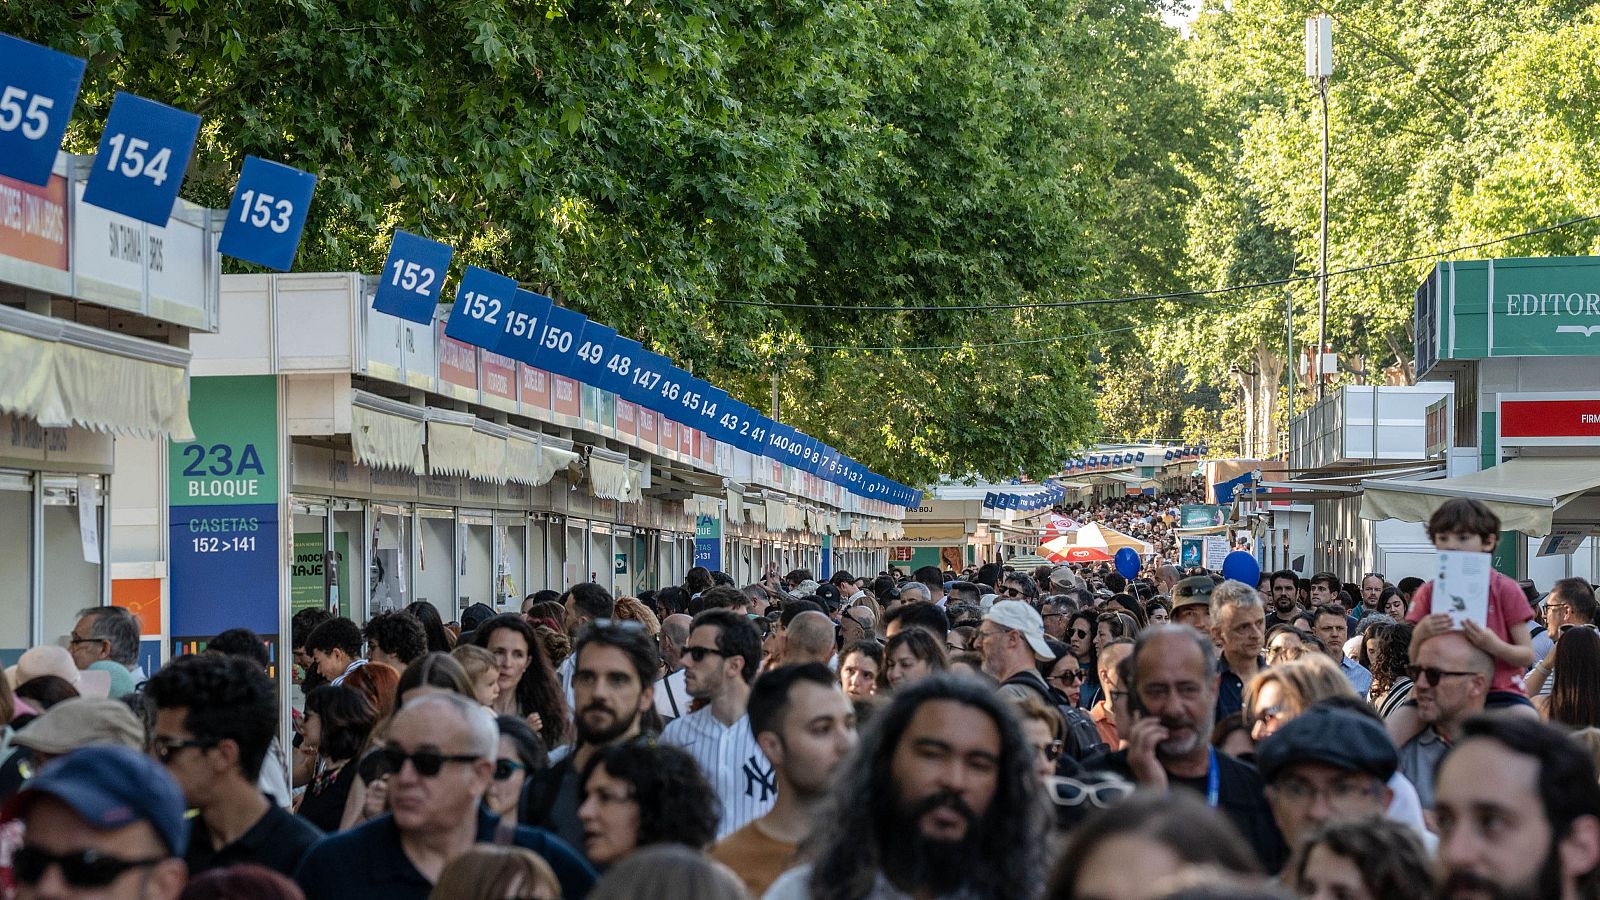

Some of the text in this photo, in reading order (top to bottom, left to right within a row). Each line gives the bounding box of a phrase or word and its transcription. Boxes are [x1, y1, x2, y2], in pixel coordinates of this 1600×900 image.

[0, 85, 54, 141] 55
[106, 132, 172, 187] 154
[240, 189, 294, 234] 153
[392, 258, 436, 297] 152
[463, 291, 503, 325] 152
[1506, 292, 1600, 317] EDITOR
[505, 310, 537, 340] 151
[577, 341, 603, 365] 49
[607, 354, 632, 377] 48
[632, 367, 661, 391] 147
[661, 380, 681, 401] 46
[682, 391, 701, 411] 45
[719, 412, 738, 431] 43
[1581, 413, 1600, 424] FIRM
[739, 421, 750, 436] 2
[751, 426, 765, 443] 41
[769, 433, 789, 450] 140
[788, 442, 802, 456] 40
[183, 443, 265, 477] 23A
[803, 447, 811, 459] 9
[811, 452, 819, 464] 8
[821, 455, 829, 468] 7
[829, 460, 836, 471] 6
[836, 463, 843, 474] 5
[188, 479, 259, 498] BLOQUE
[189, 517, 259, 533] CASETAS
[696, 527, 712, 536] QUE
[292, 564, 323, 577] IAJE
